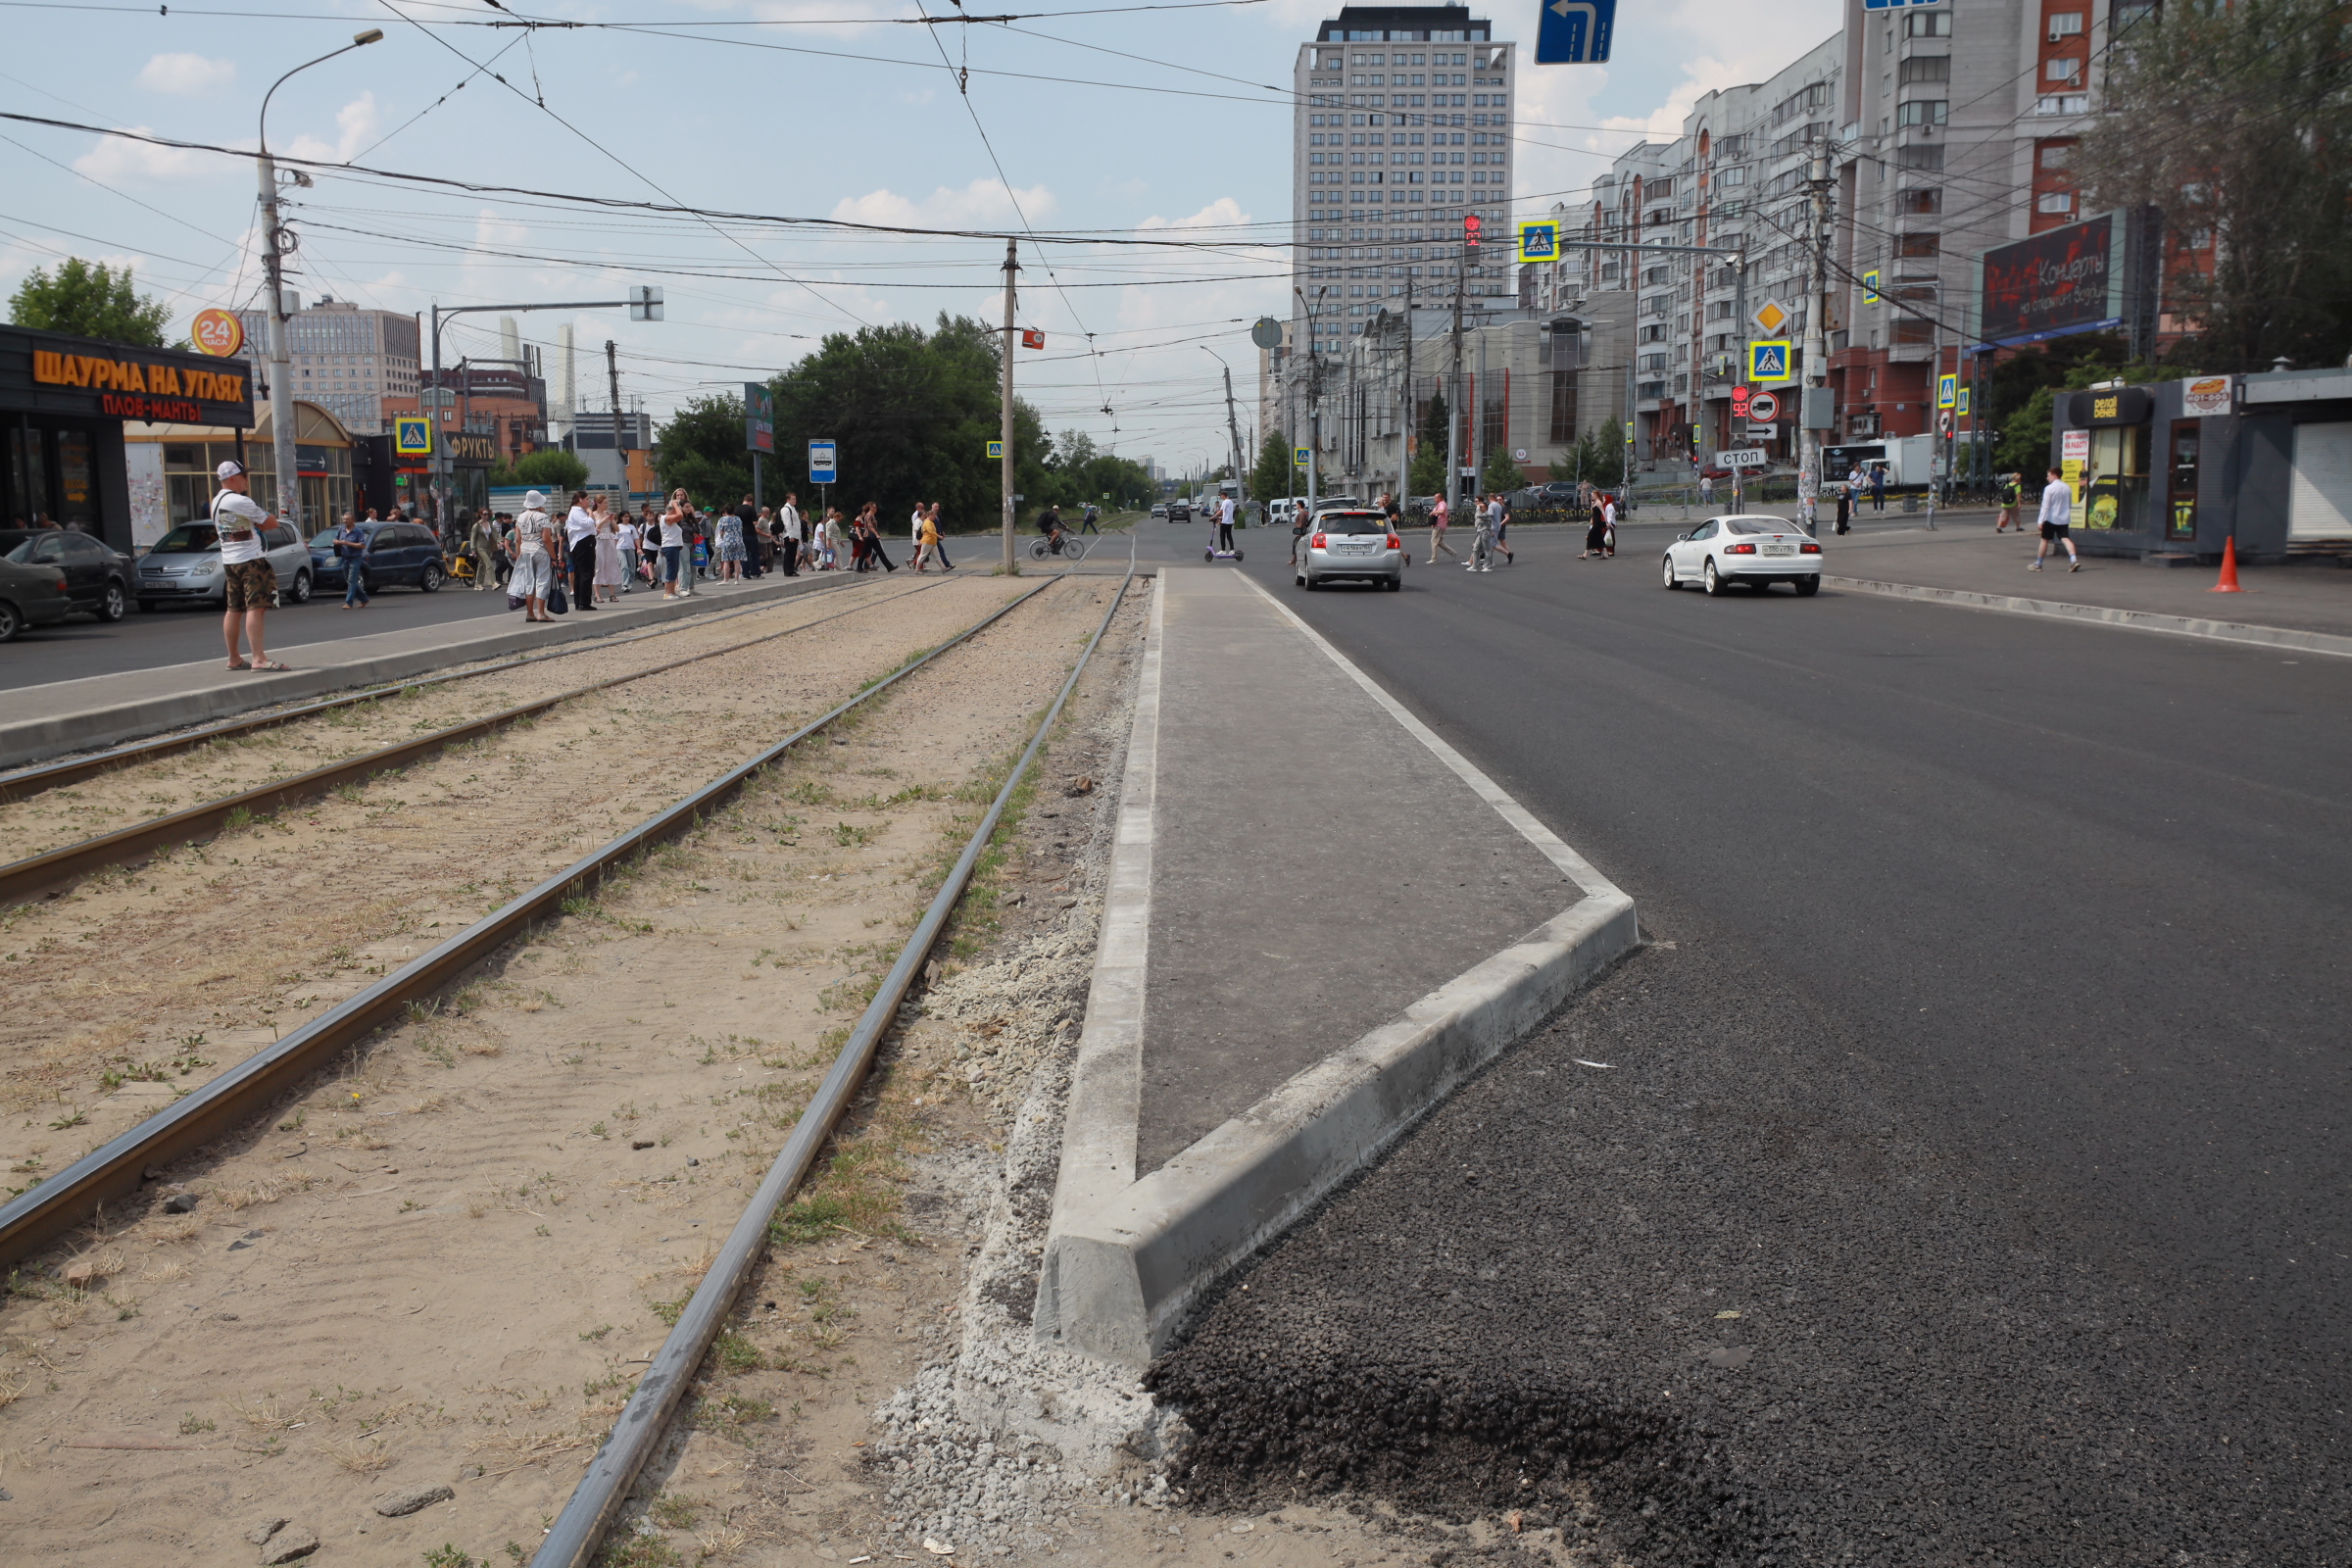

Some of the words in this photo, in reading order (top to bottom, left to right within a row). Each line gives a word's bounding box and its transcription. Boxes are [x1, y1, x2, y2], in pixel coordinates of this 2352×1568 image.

[2038, 253, 2104, 286] Концерты
[200, 320, 230, 339] 24
[33, 350, 146, 392] ШАУРМА
[147, 364, 180, 396] НА
[181, 368, 244, 403] УГЛЯХ
[102, 394, 202, 421] ПЛОВ-МАНТЫ
[1733, 403, 1747, 416] 92
[452, 436, 495, 459] ФРУКТЫ
[1724, 452, 1758, 465] СТОП
